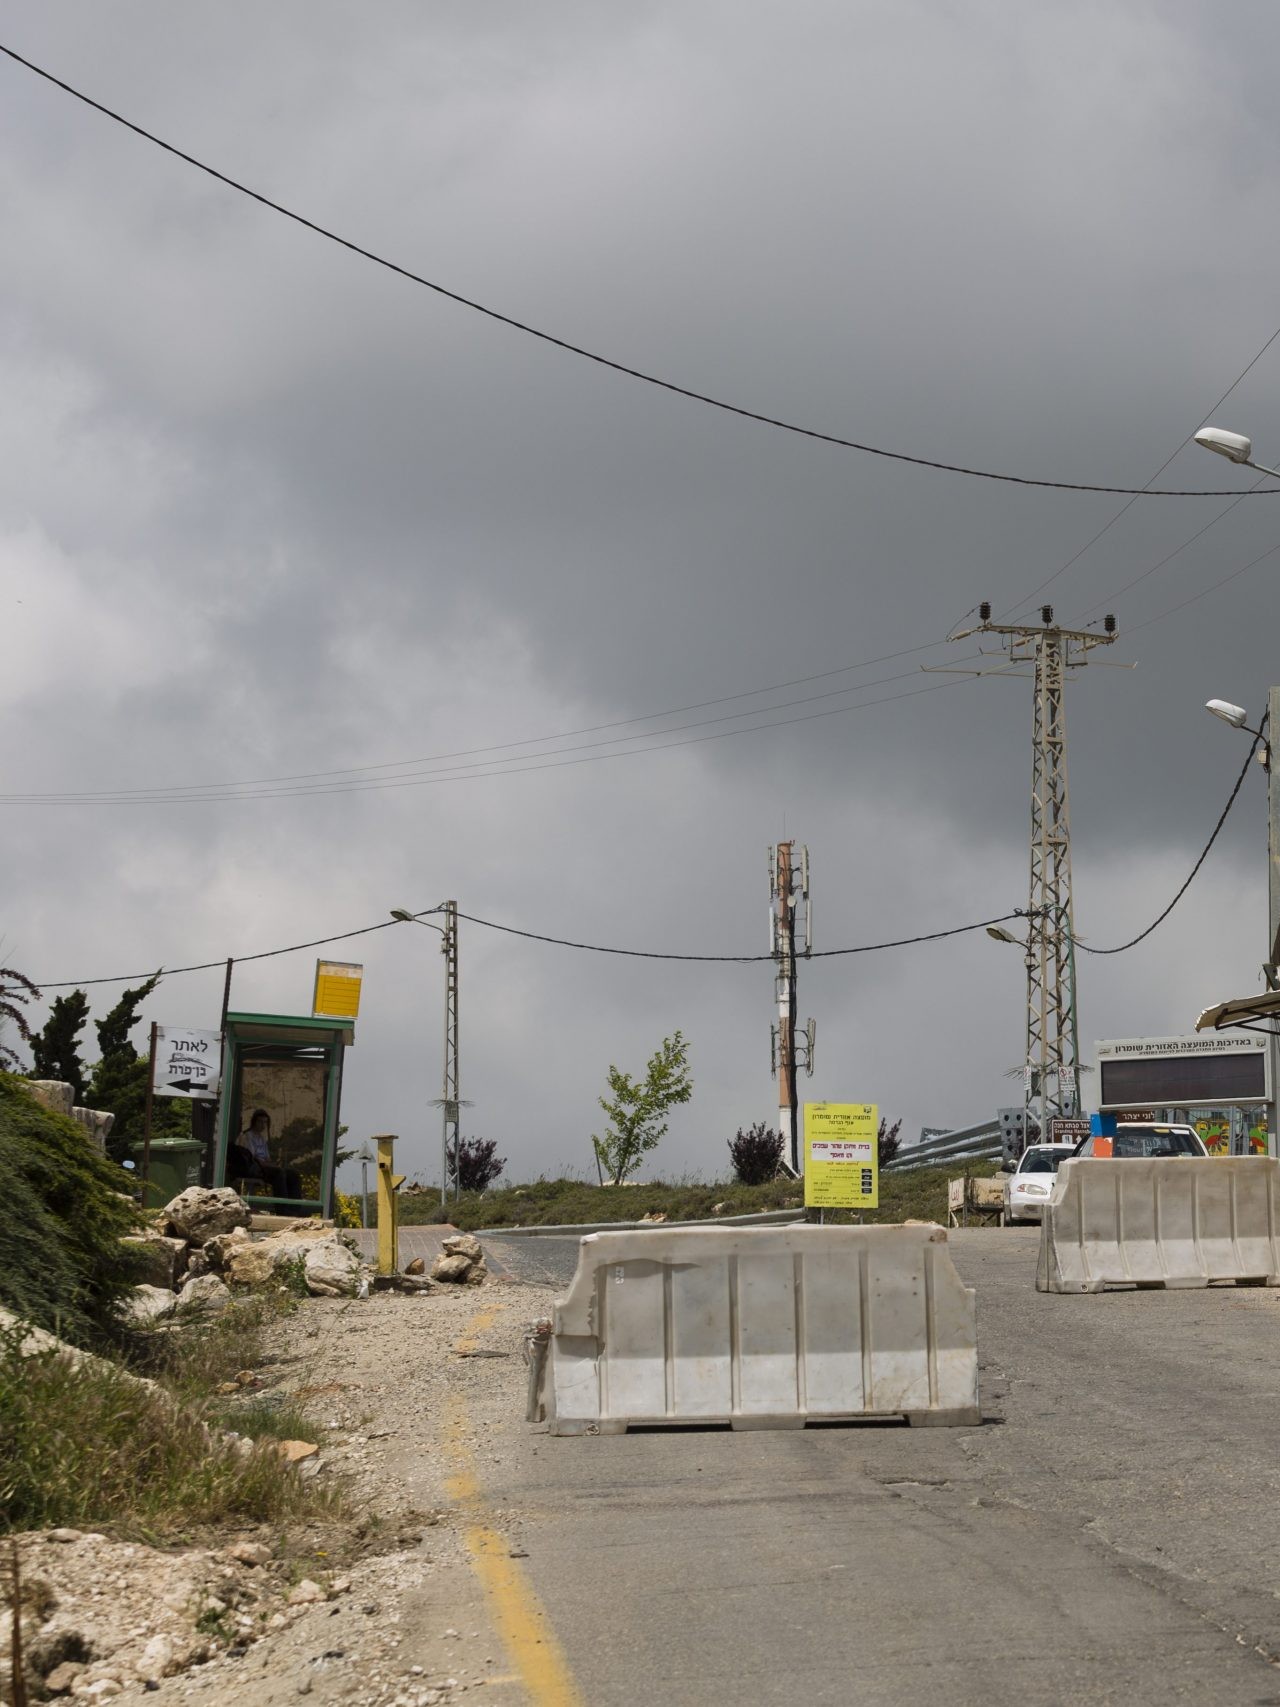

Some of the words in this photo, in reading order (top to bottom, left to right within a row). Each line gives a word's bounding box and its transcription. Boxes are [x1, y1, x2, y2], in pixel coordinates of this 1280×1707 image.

[170, 1040, 208, 1052] לאתר
[1145, 1042, 1179, 1051] האזורית
[1181, 1040, 1215, 1049] המועצה
[1216, 1039, 1251, 1047] באדיבות
[1115, 1045, 1144, 1054] שומרון
